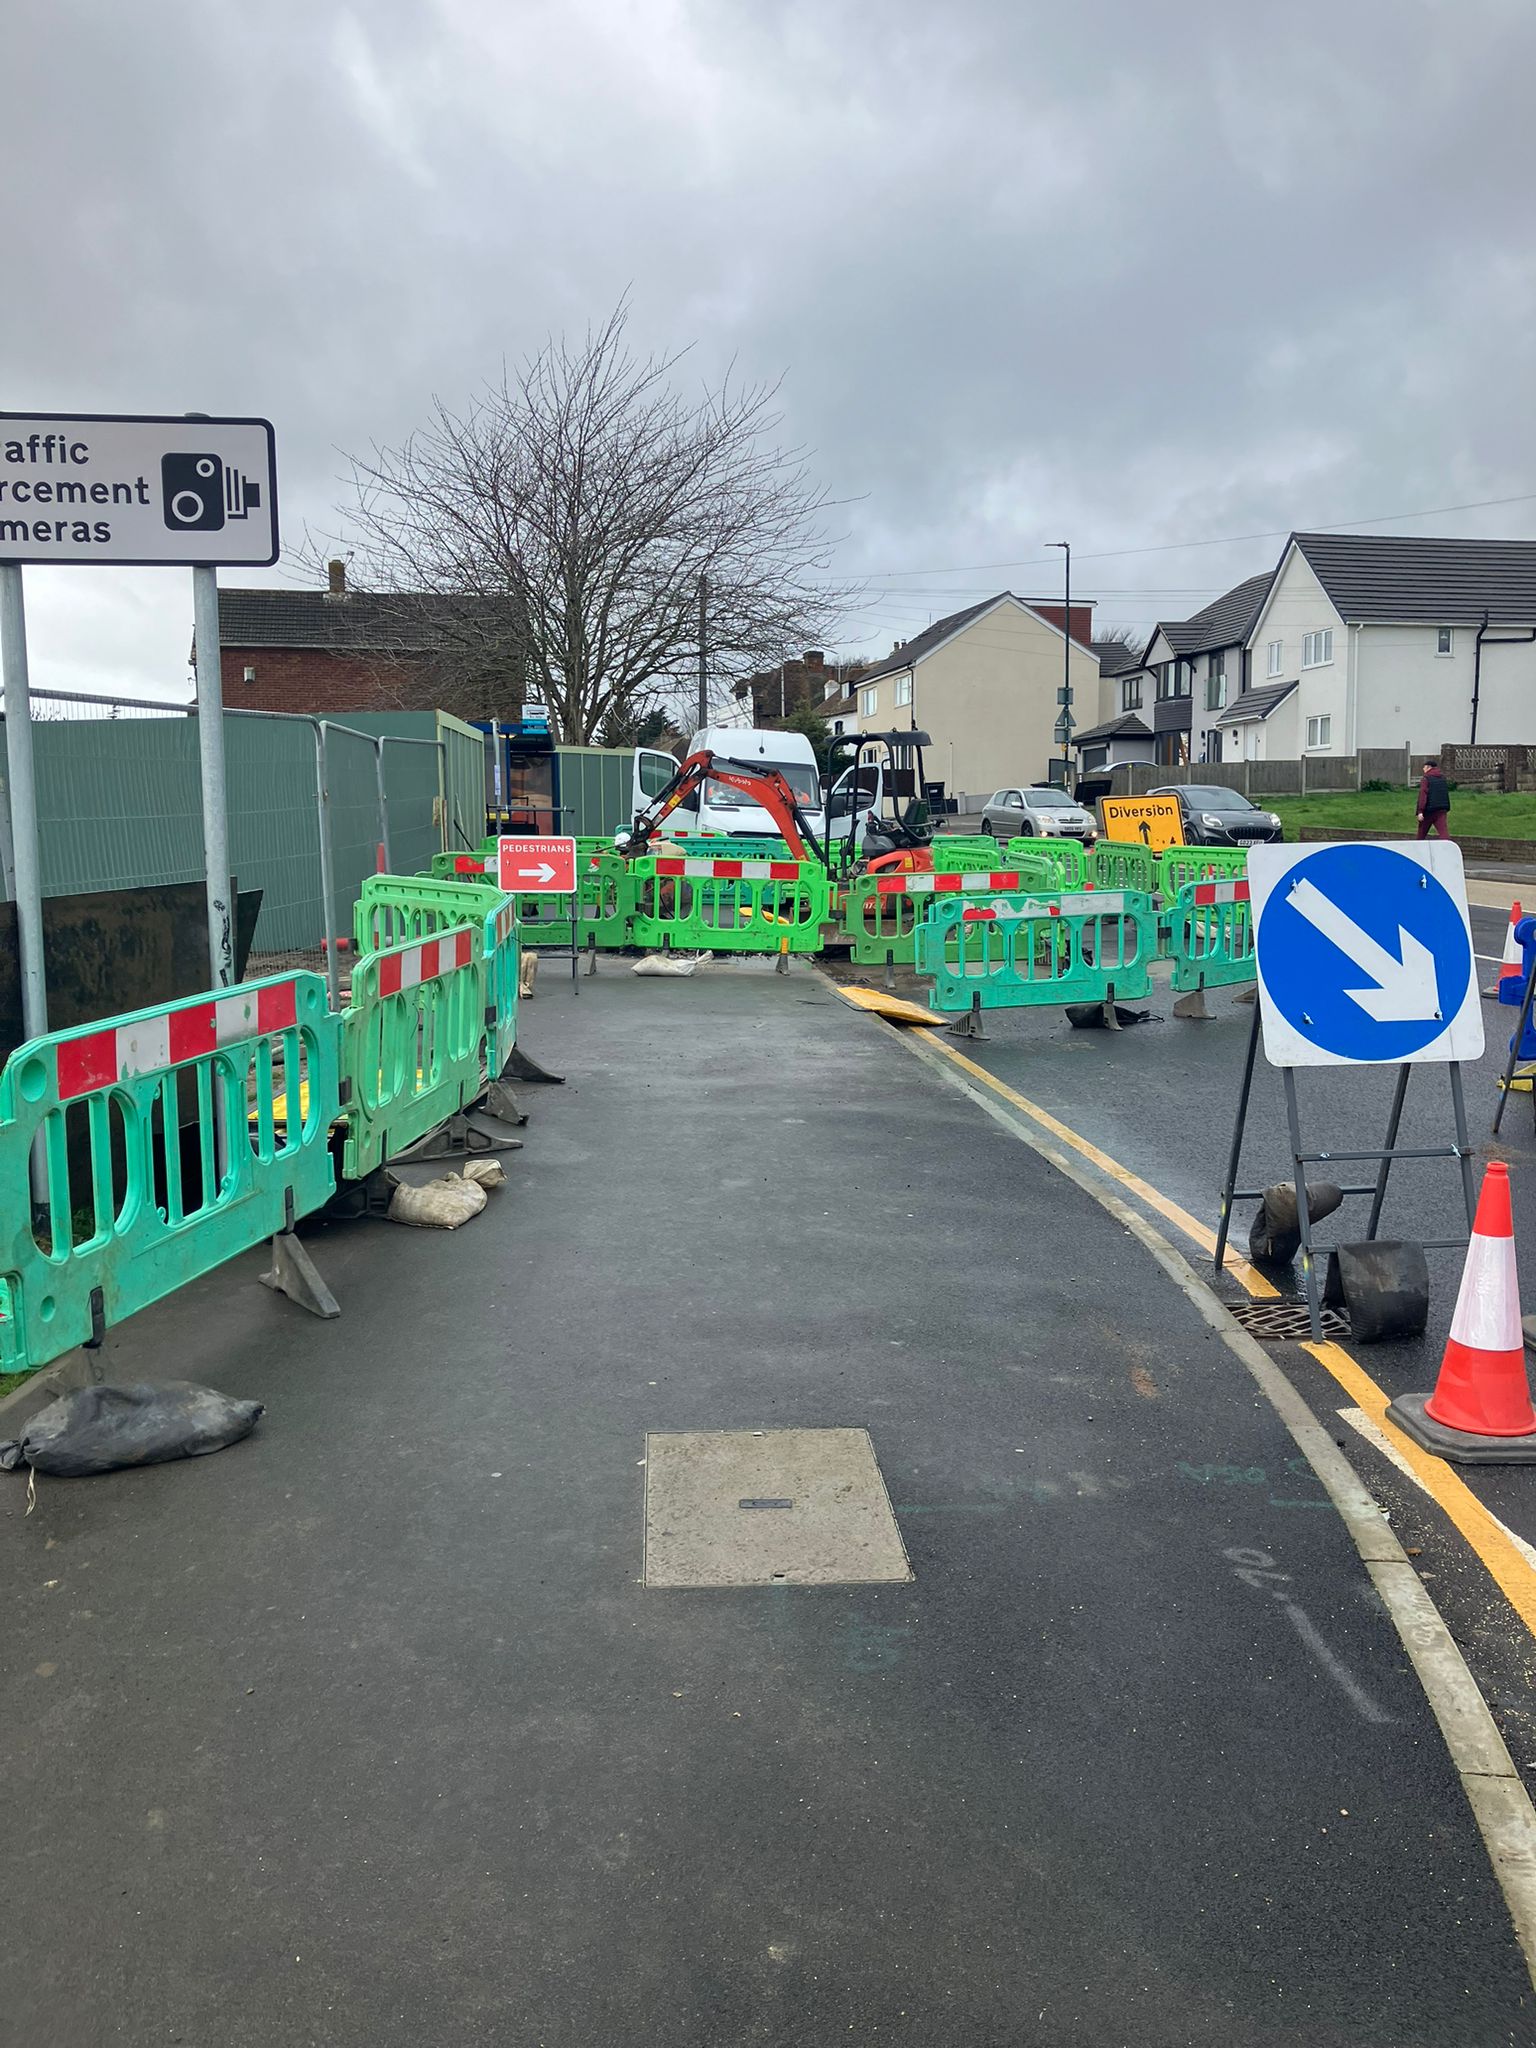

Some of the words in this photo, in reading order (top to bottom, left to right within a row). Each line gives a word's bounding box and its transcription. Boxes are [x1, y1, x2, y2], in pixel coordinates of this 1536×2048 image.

[3, 434, 89, 465] affic
[0, 476, 150, 505] rcement
[0, 520, 111, 543] meras
[1109, 804, 1174, 819] Diversion
[502, 844, 572, 853] PEDESTRIANS
